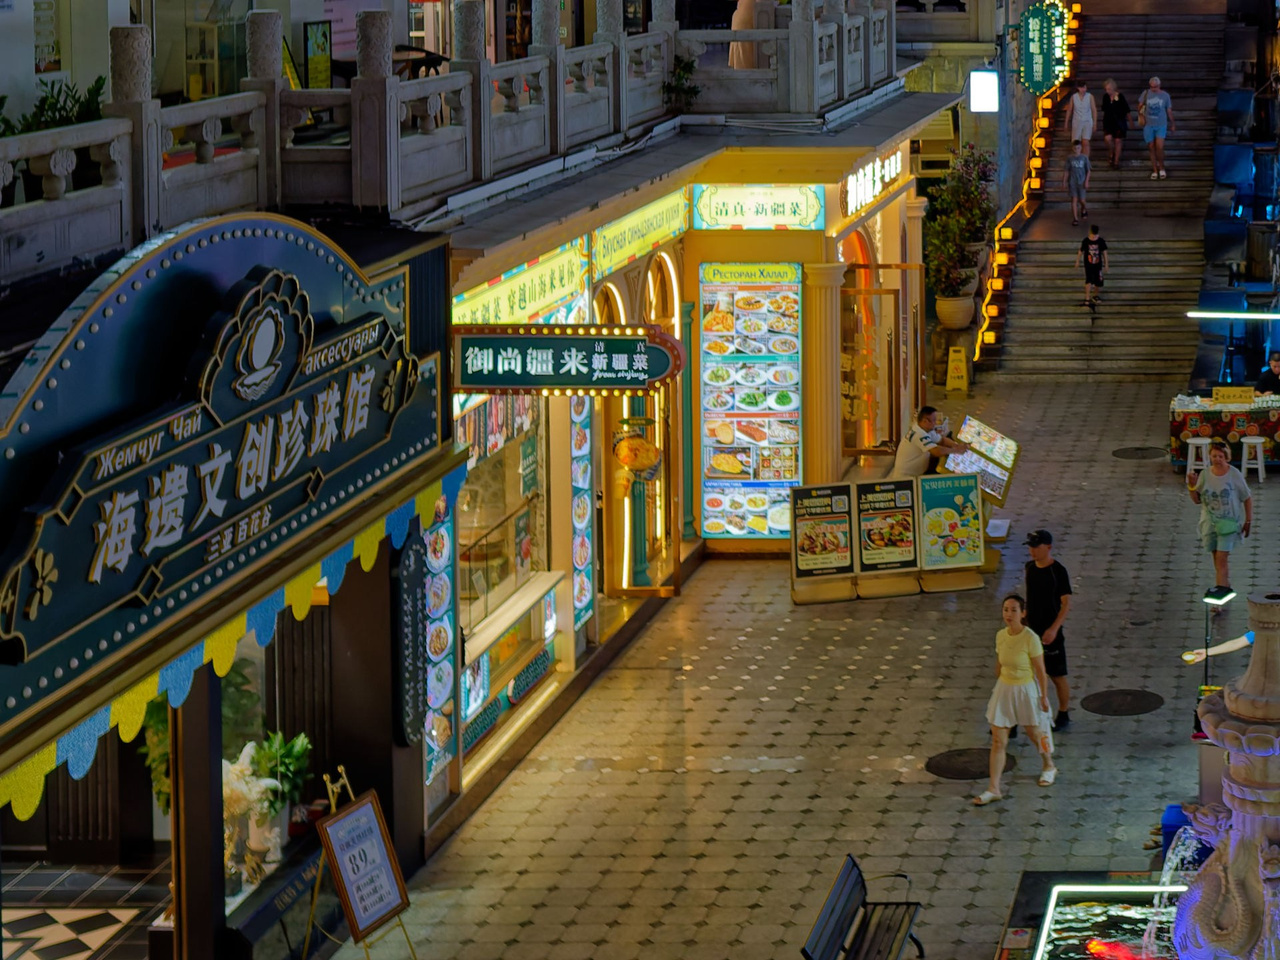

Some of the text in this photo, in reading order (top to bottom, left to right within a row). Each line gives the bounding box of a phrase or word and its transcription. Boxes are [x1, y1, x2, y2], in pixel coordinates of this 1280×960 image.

[303, 323, 380, 376] аксессуары
[465, 346, 649, 376] 御尚疆来 新疆菜
[93, 407, 203, 480] Жемчуг Чай
